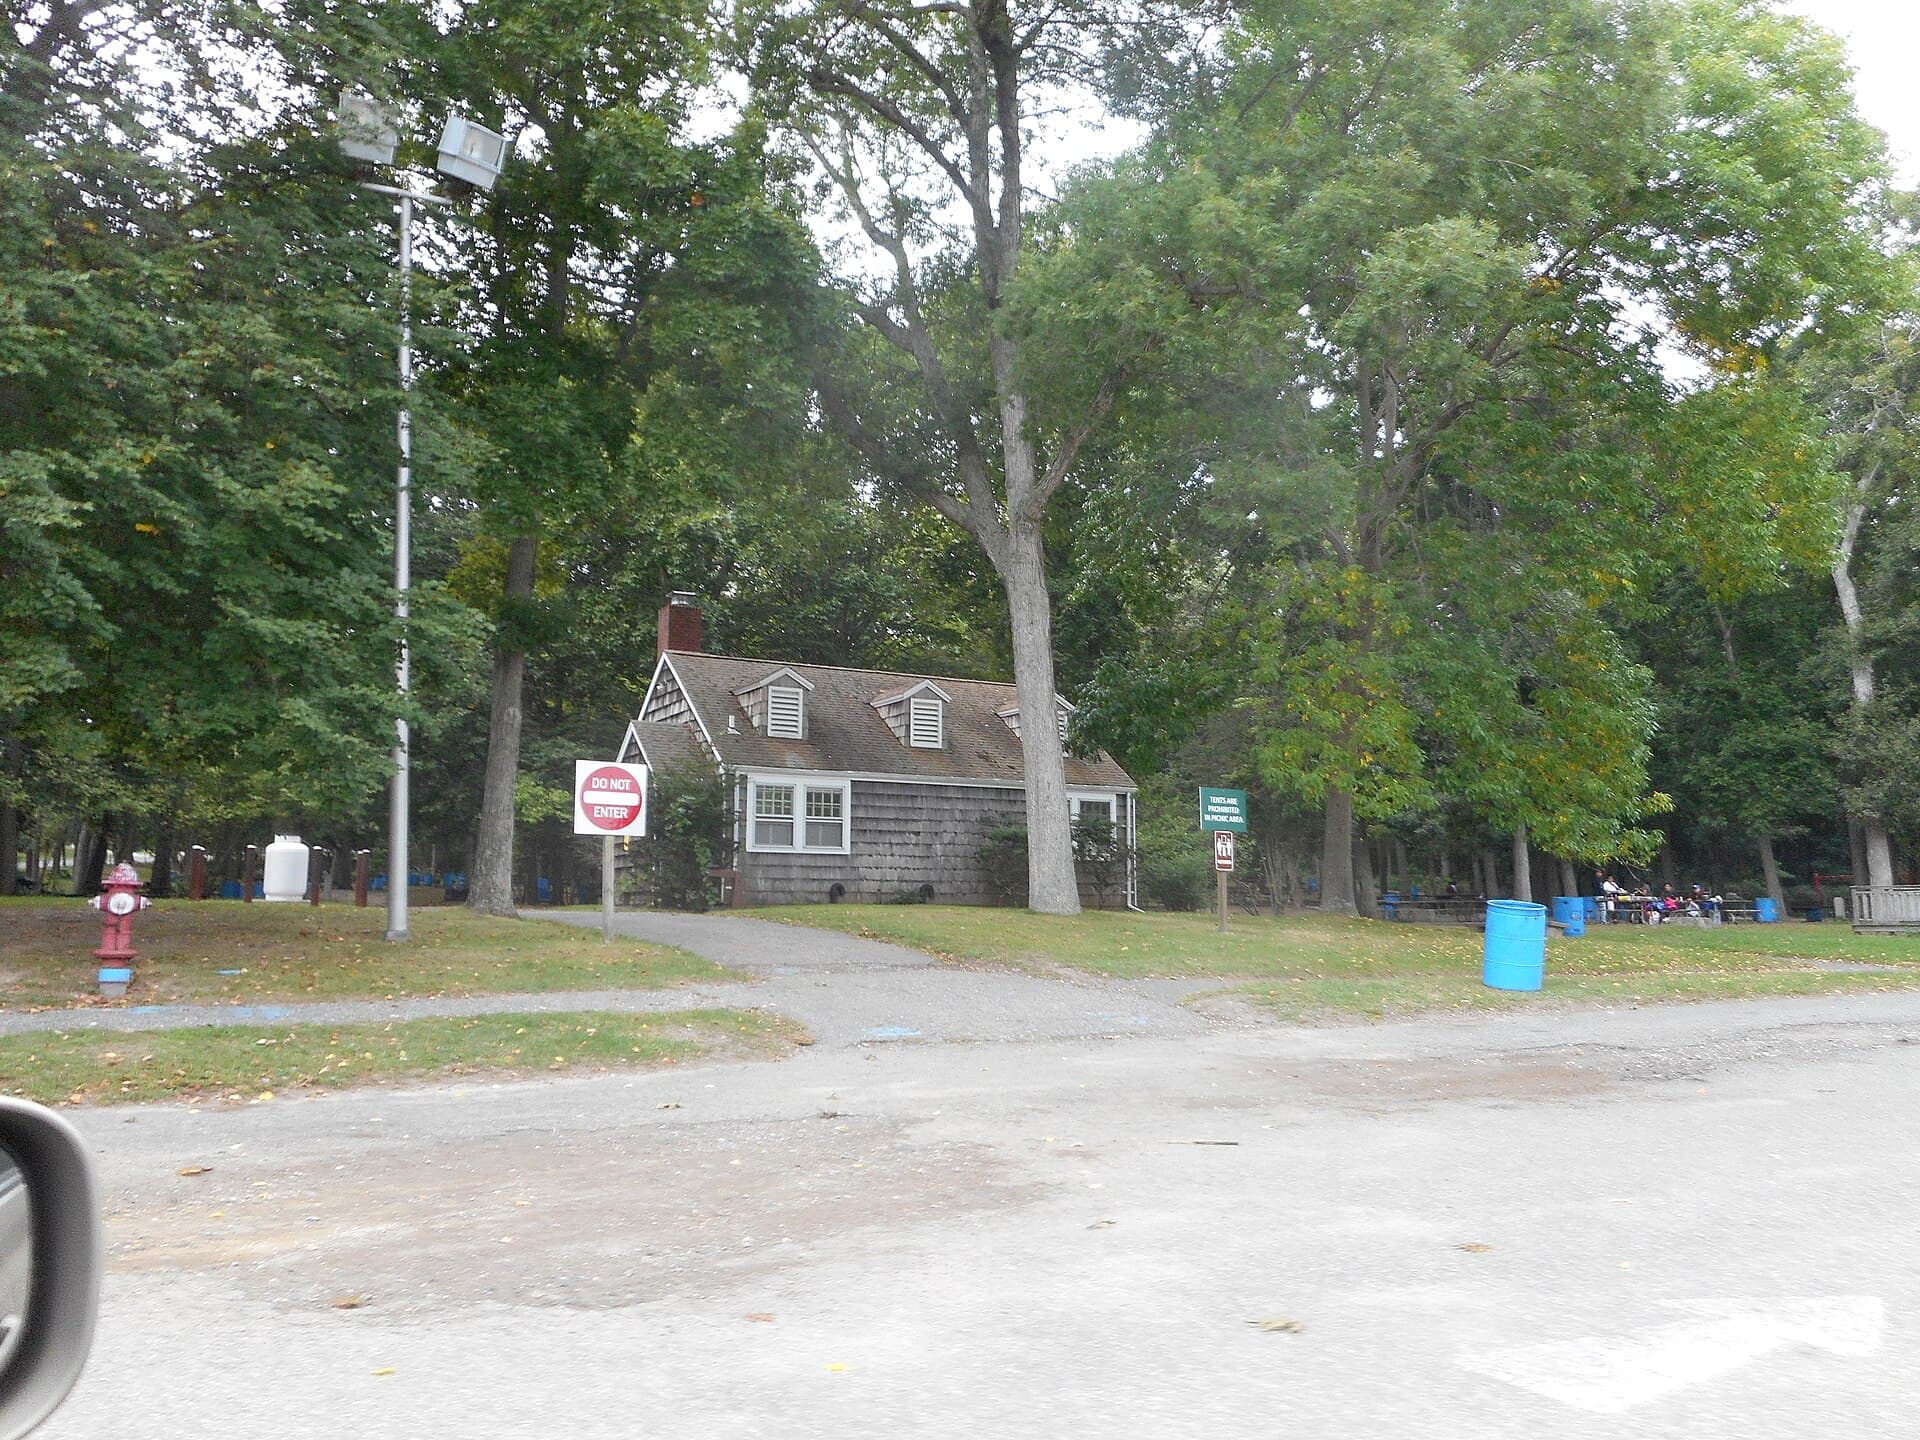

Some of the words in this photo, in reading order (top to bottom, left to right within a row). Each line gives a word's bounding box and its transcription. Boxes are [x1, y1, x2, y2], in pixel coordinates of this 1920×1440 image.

[591, 777, 608, 789] DO
[610, 778, 632, 790] NOT
[1226, 797, 1237, 805] ARE
[594, 806, 628, 818] ENTER
[1208, 805, 1239, 813] PROHIBITED
